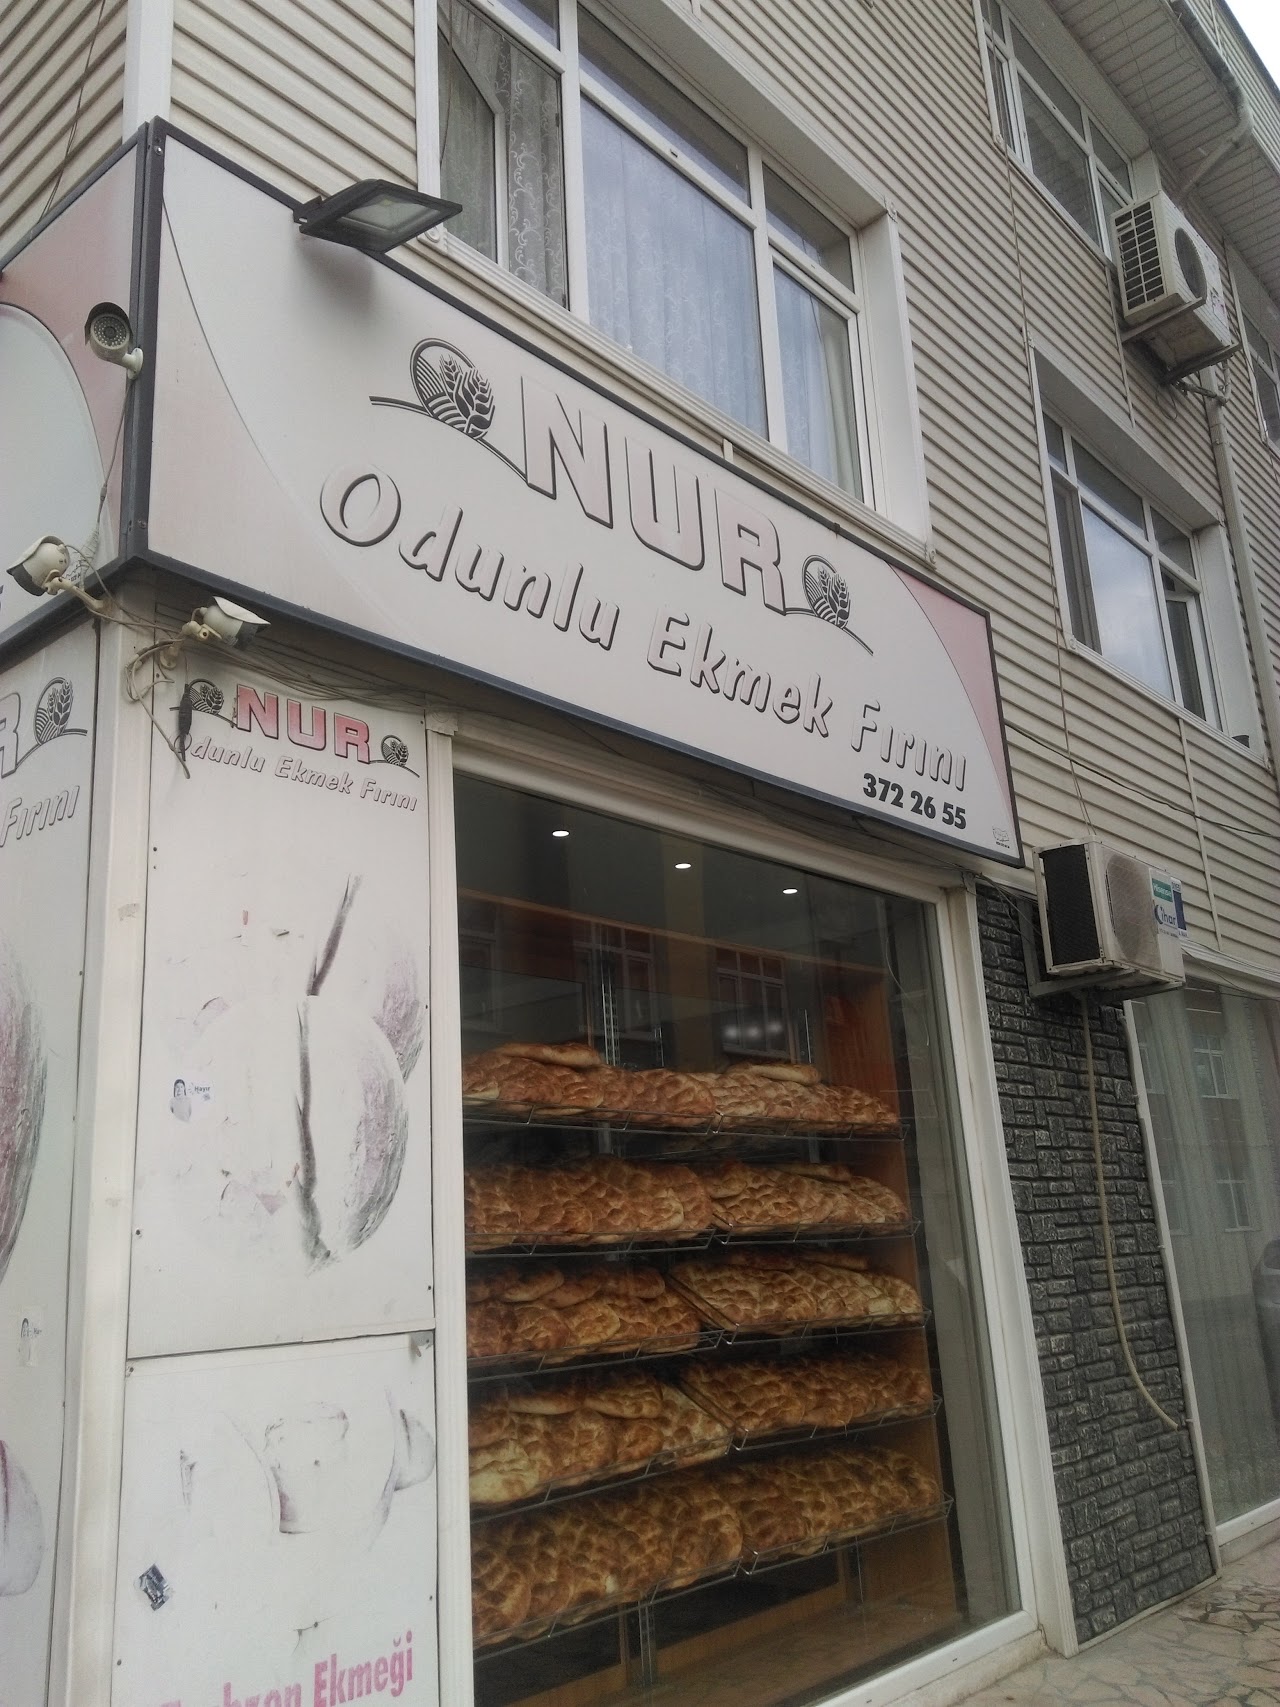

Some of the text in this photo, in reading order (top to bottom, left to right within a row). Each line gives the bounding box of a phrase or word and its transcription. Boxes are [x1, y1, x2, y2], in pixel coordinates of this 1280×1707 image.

[521, 374, 786, 616] NUR
[320, 463, 967, 792] Odunlu Ekmek Fırını
[237, 684, 370, 764] NUR
[275, 756, 354, 794] Ekmek
[360, 778, 418, 812] Fırını
[863, 773, 967, 829] 372 26 55
[313, 1630, 412, 1707] Ekmeği
